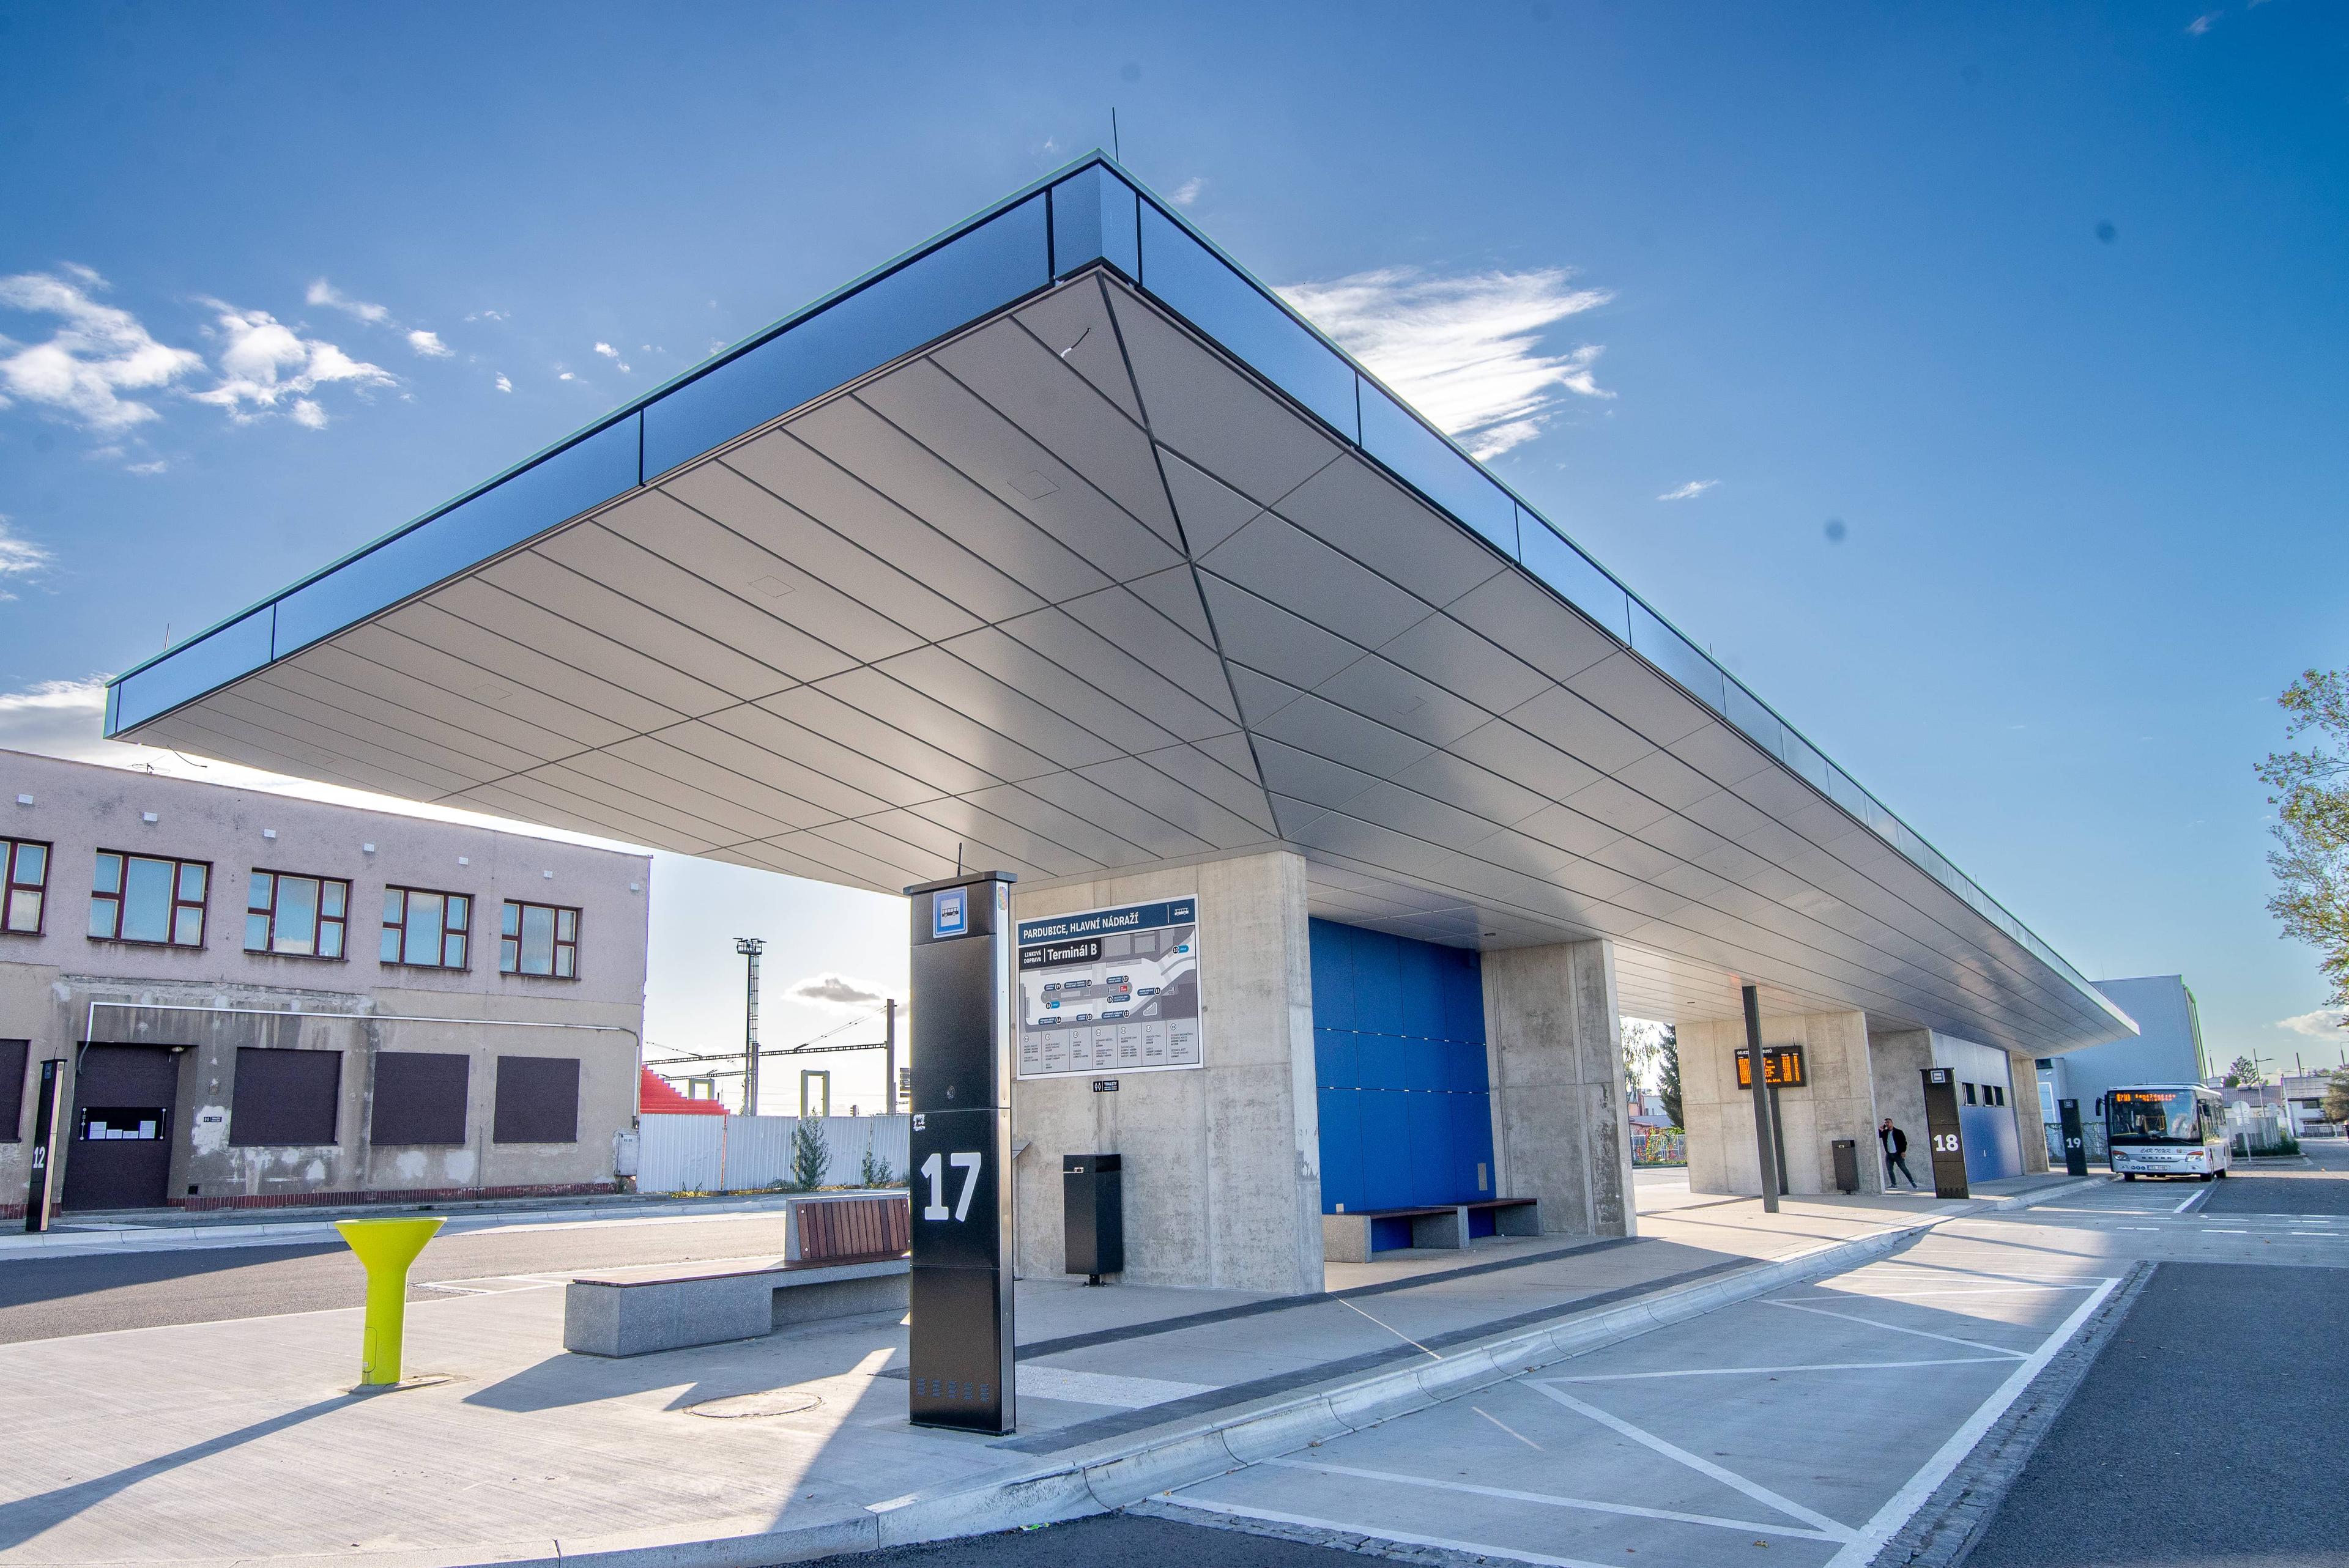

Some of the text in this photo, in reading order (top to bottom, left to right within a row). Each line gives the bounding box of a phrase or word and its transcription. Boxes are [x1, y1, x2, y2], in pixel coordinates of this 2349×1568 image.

[1023, 912, 1139, 939] PARDUBICE, HLAVNÍ NÁDRAŽÍ
[1024, 949, 1041, 958] LINKOVÁ
[1047, 944, 1097, 961] Terminál B
[1934, 1134, 1959, 1152] 18
[2066, 1137, 2081, 1148] 19
[33, 1146, 45, 1168] 12
[921, 1152, 981, 1222] 17
